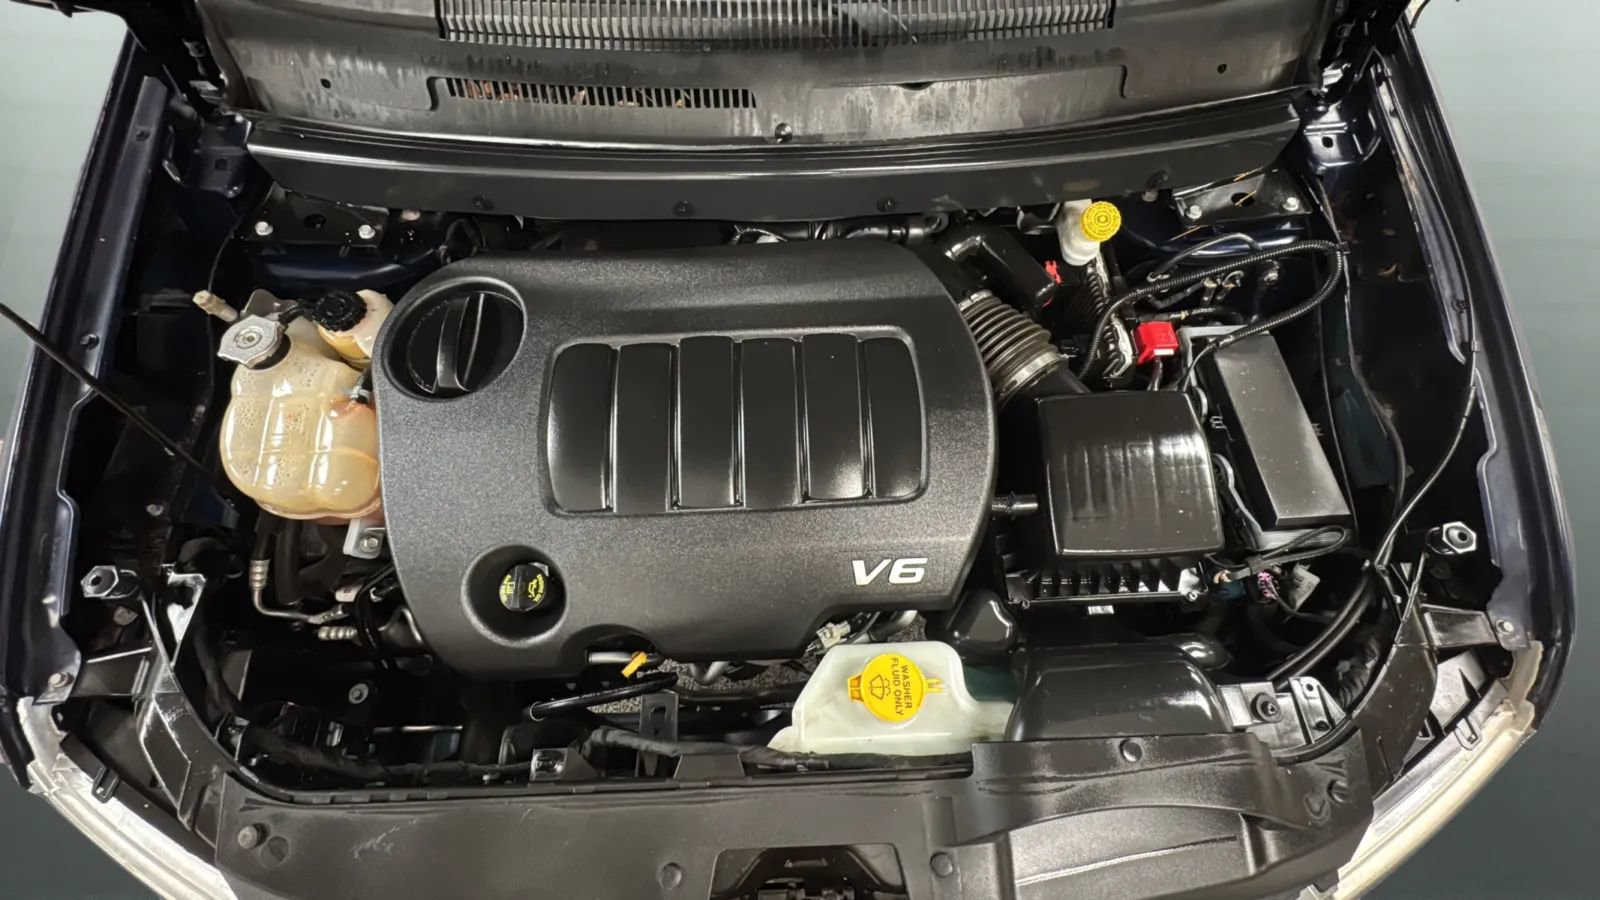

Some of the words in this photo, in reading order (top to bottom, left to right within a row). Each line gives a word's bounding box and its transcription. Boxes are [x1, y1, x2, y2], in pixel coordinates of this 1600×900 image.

[852, 557, 928, 586] V6
[891, 657, 901, 687] FLUID
[901, 664, 913, 709] WASHER
[893, 689, 904, 716] ONLY
